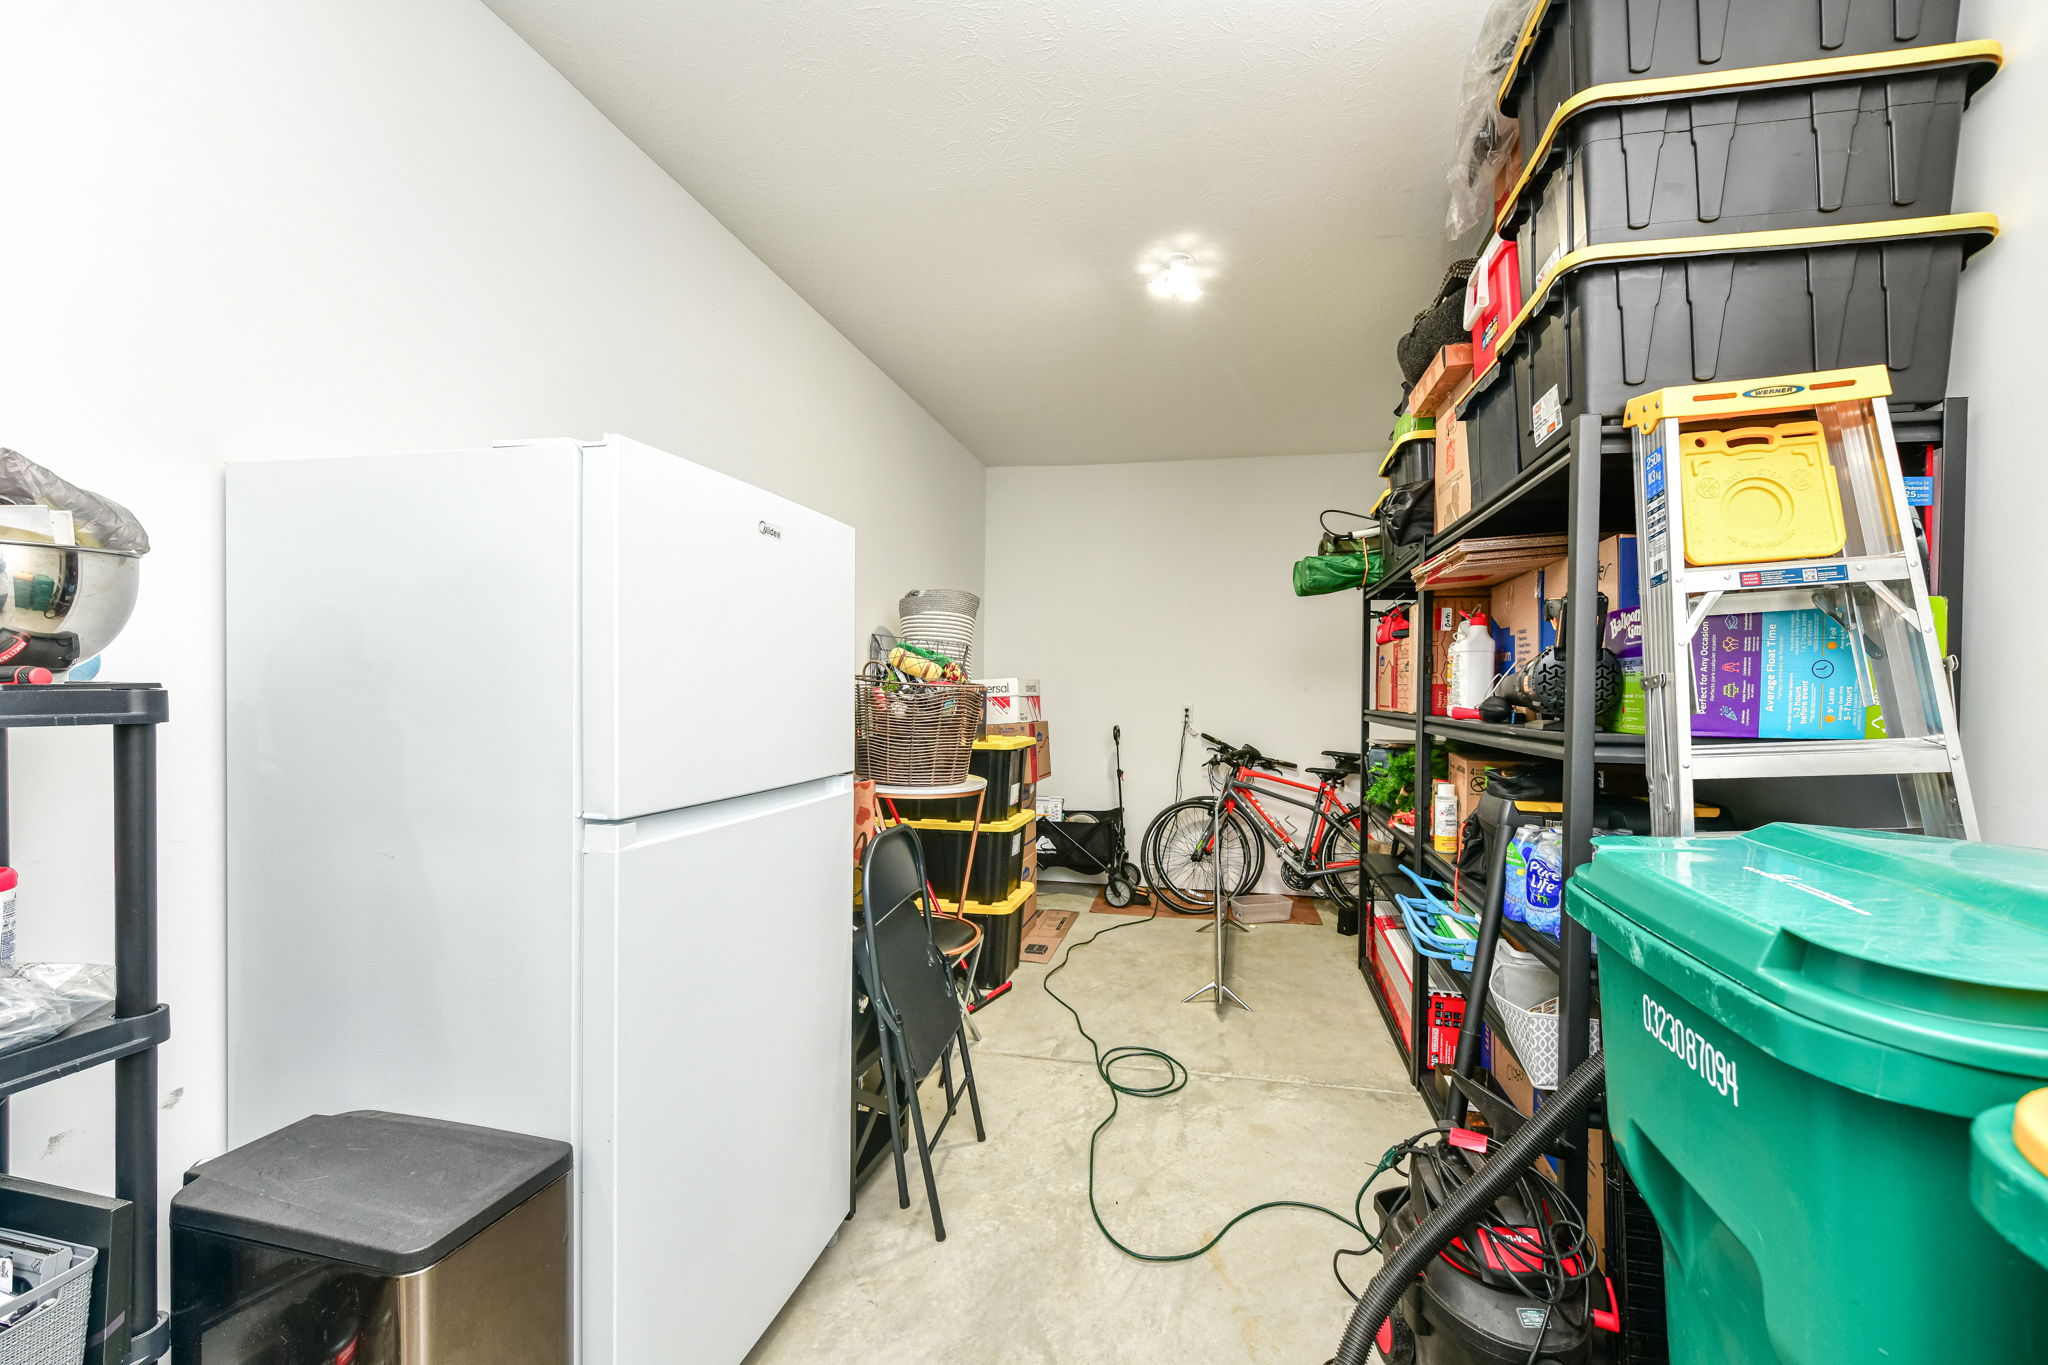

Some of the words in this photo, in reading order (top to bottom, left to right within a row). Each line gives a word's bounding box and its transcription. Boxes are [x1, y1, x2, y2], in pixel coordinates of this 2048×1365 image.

[1755, 386, 1793, 396] WERNER
[1609, 608, 1641, 640] Balloon
[1626, 623, 1642, 639] tim
[1829, 627, 1837, 639] Foil
[1700, 621, 1710, 656] Occasion
[1766, 624, 1777, 646] Time
[1700, 658, 1710, 673] Any
[1765, 649, 1776, 672] Float
[986, 682, 1010, 694] ersal
[1699, 673, 1708, 686] for
[1801, 680, 1809, 699] event
[1698, 686, 1708, 715] Perfect
[1709, 682, 1717, 702] Perfecto
[1764, 674, 1777, 712] Average
[1828, 687, 1836, 705] Latex
[1844, 686, 1853, 707] hours
[1800, 700, 1808, 725] before
[1529, 860, 1561, 882] Pure
[1530, 873, 1556, 894] Life
[1642, 994, 1739, 1107] 0323087094
